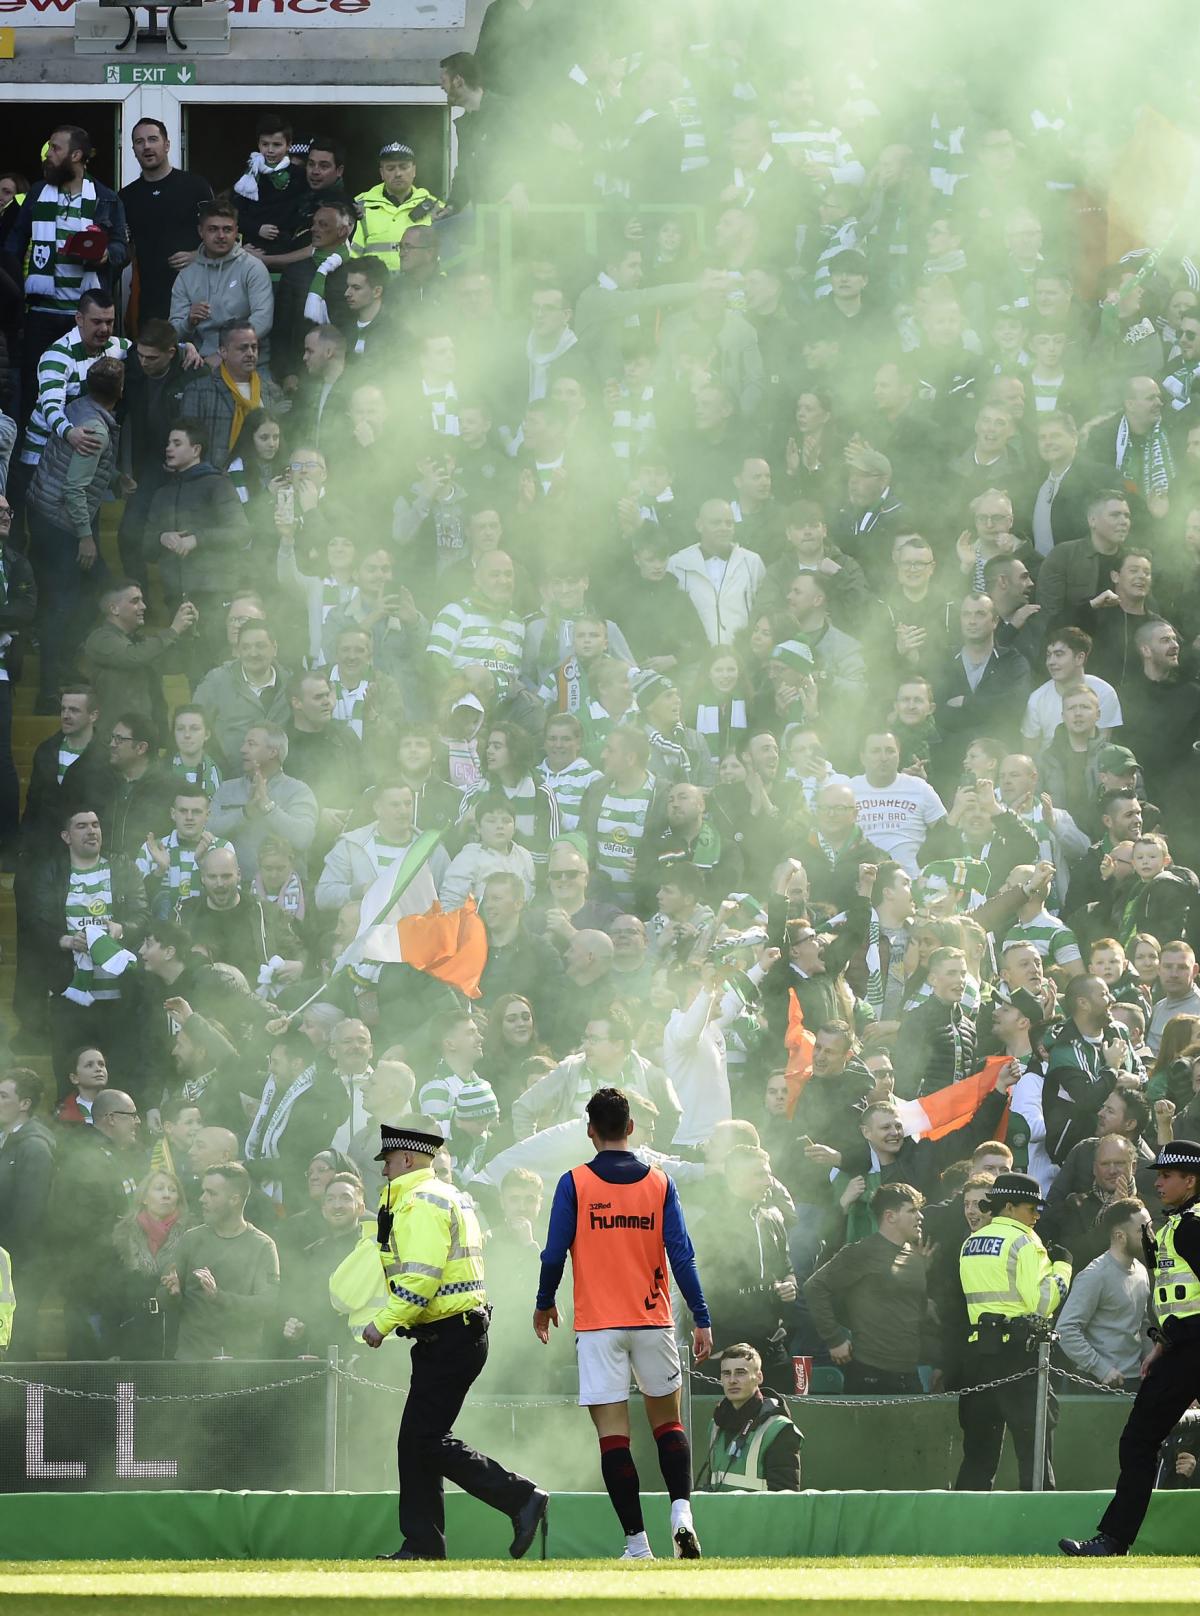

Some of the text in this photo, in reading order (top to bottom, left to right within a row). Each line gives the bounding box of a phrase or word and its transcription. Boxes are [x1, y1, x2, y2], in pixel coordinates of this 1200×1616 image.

[132, 69, 167, 82] EXIT
[590, 1212, 655, 1231] hummel
[964, 1239, 1002, 1254] POLICE
